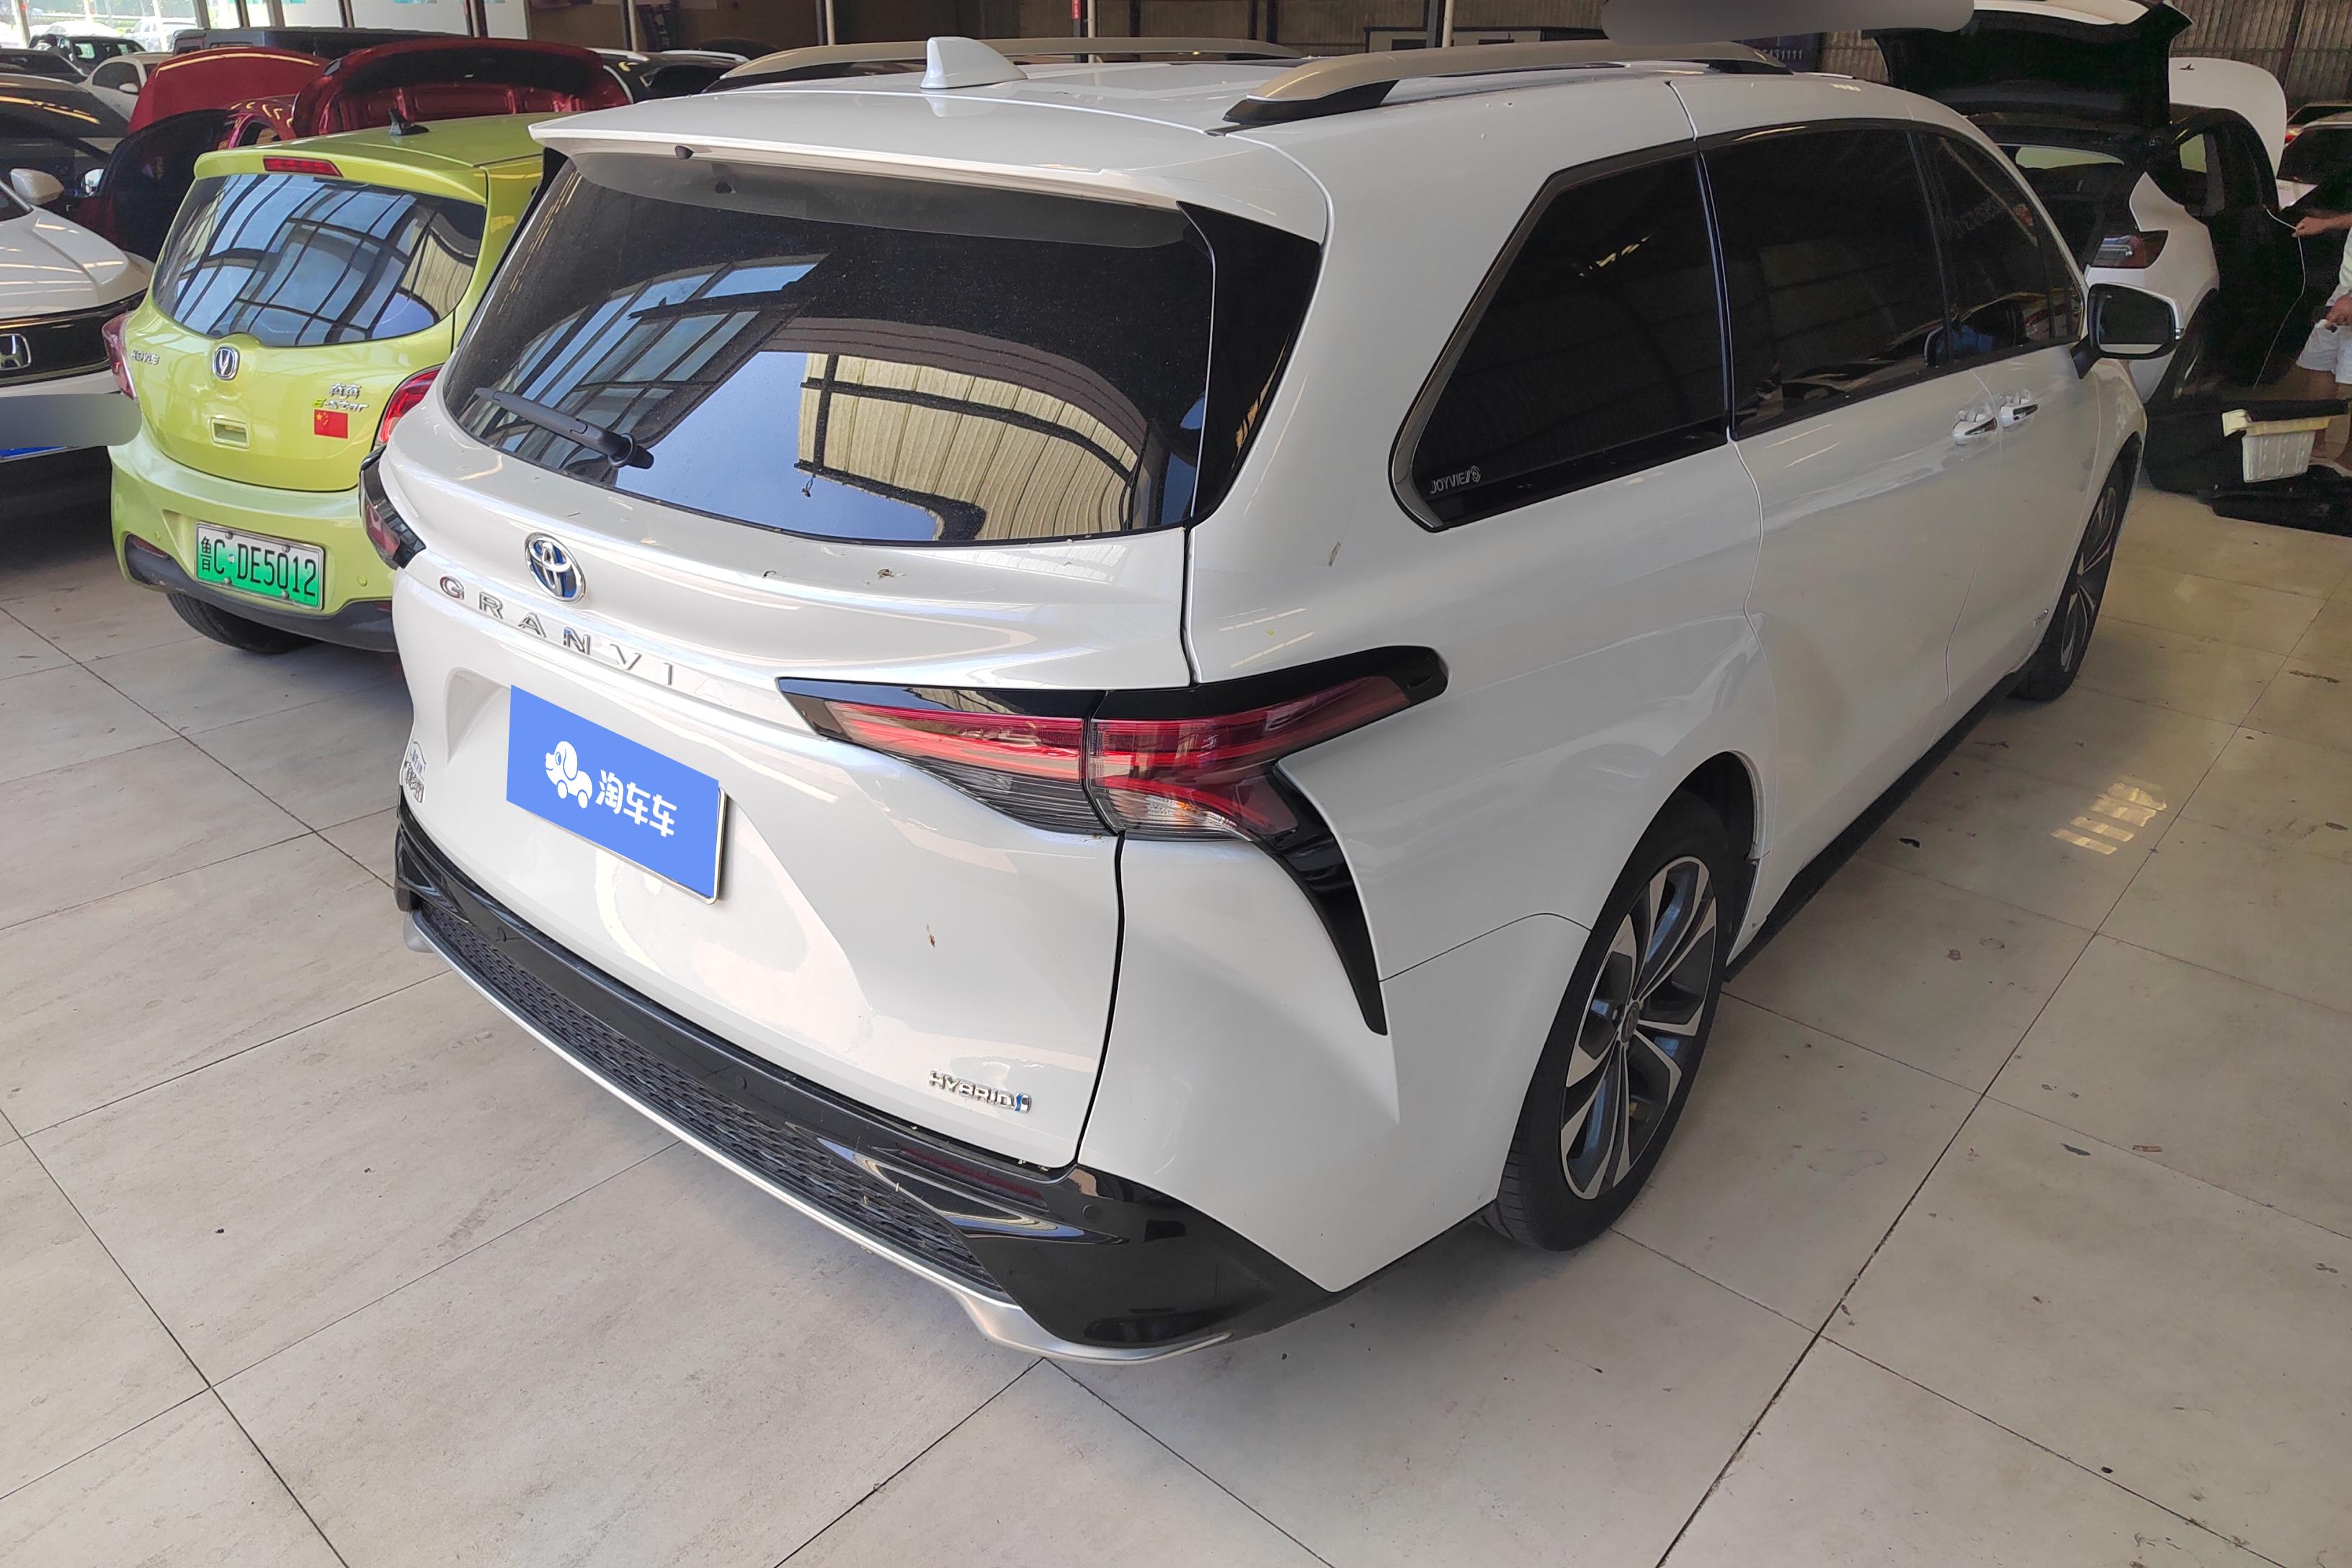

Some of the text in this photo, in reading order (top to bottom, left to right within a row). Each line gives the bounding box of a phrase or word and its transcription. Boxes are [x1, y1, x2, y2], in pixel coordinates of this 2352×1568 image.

[236, 543, 316, 597] DE5012
[439, 575, 733, 707] GRANVIA
[928, 1070, 1015, 1110] HYBRID
